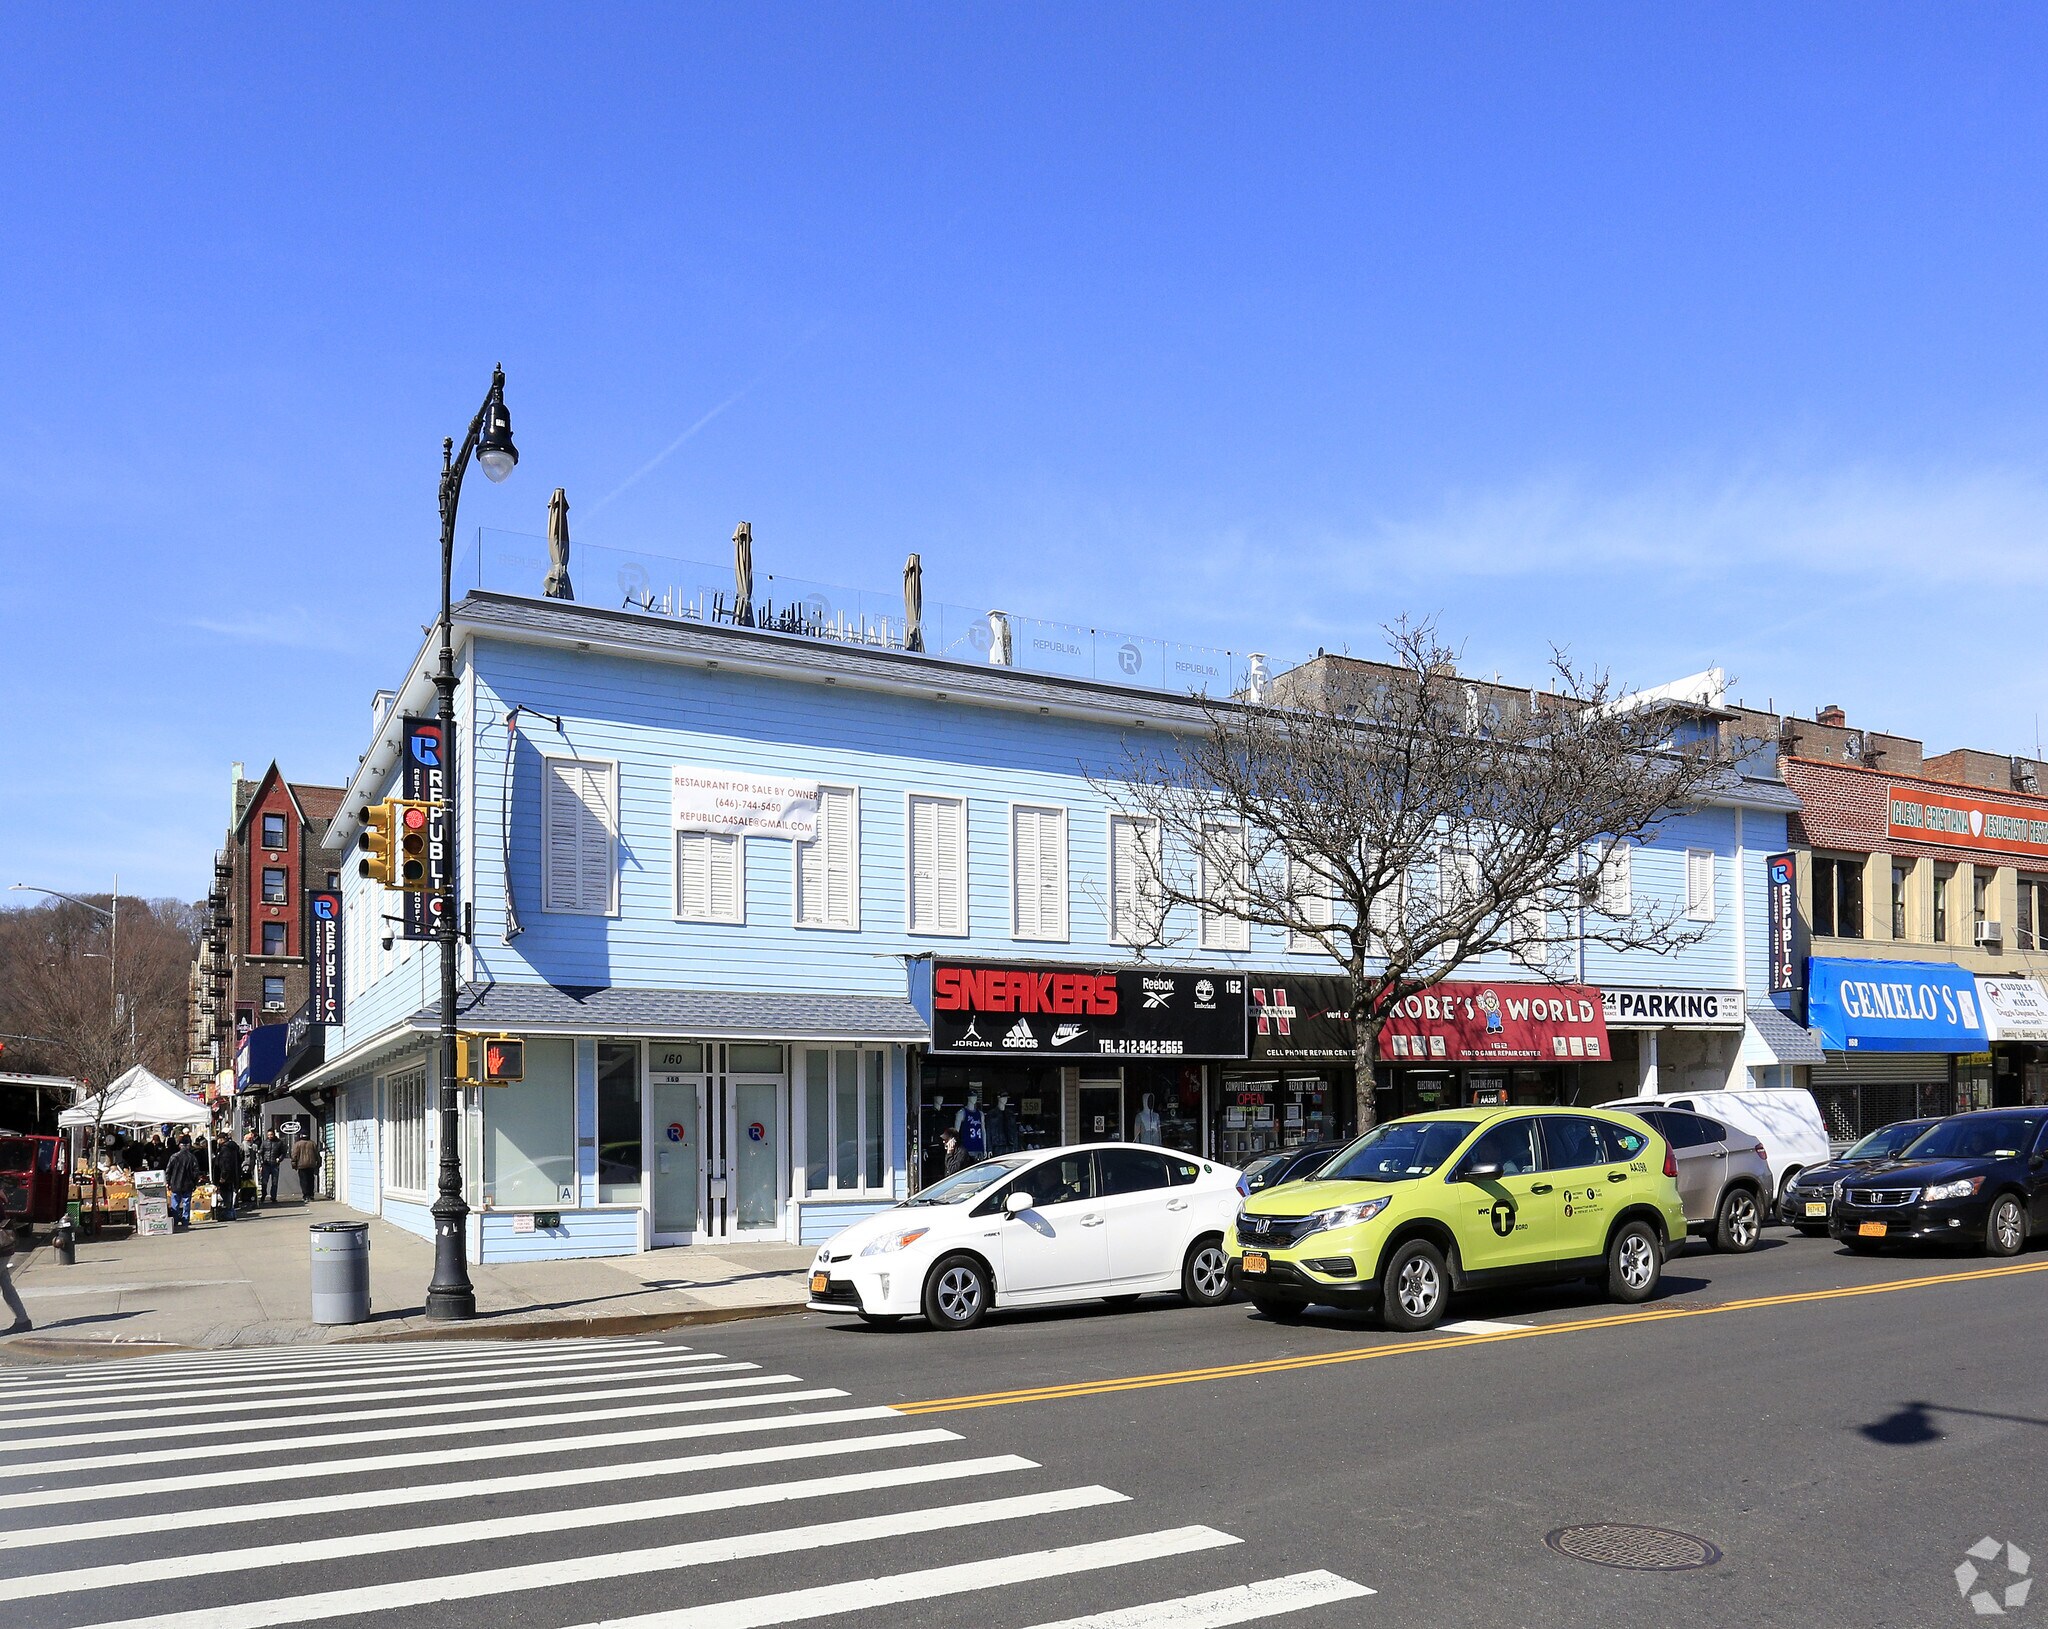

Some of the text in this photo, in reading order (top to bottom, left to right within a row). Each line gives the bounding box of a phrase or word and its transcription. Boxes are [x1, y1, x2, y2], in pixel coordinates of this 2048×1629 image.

[874, 614, 928, 630] REPUBA
[1033, 638, 1082, 656] REPUBLICA
[1175, 661, 1220, 677] REPUBLICA
[674, 777, 818, 800] RESTAURANT FOR SALE BY OWNER
[715, 797, 782, 813] (646)-744-5450
[680, 811, 813, 832] REPUBLICA4SALE@GMAIL.COM
[1890, 800, 1924, 828] IGLESIA
[1924, 805, 1970, 835] CRISTIANA
[1984, 814, 2029, 842] JESUCRISTO
[1781, 884, 1793, 989] REPUBLICA
[324, 920, 336, 1022] REPUBLICA
[1142, 977, 1175, 991] Reebok
[1225, 980, 1242, 994] 162
[2000, 983, 2033, 991] CUDDLES
[935, 968, 1118, 1015] SNEAKERS
[1194, 1001, 1217, 1010] Timberland
[1620, 993, 1718, 1018] PARKING
[2012, 999, 2038, 1007] KISSES
[1505, 997, 1595, 1024] WORLD
[1057, 1028, 1082, 1041] NIKE
[952, 1040, 993, 1048] JORDAN
[1002, 1036, 1039, 1049] adidas
[663, 1053, 683, 1065] 160
[1266, 1049, 1285, 1057] CELL
[1285, 1049, 1309, 1057] PHONE
[1309, 1049, 1334, 1057] REPAIR
[1461, 1049, 1480, 1057] VIDEO
[1225, 1081, 1249, 1092] COMPUTER
[1288, 1081, 1328, 1091] REPAIR NEW USED
[1417, 1080, 1442, 1090] ELECTRONICS
[1237, 1093, 1264, 1105] OPEN
[969, 1128, 982, 1139] 34
[561, 1187, 572, 1200] A
[1495, 1206, 1510, 1232] T
[1515, 1223, 1529, 1231] BORO
